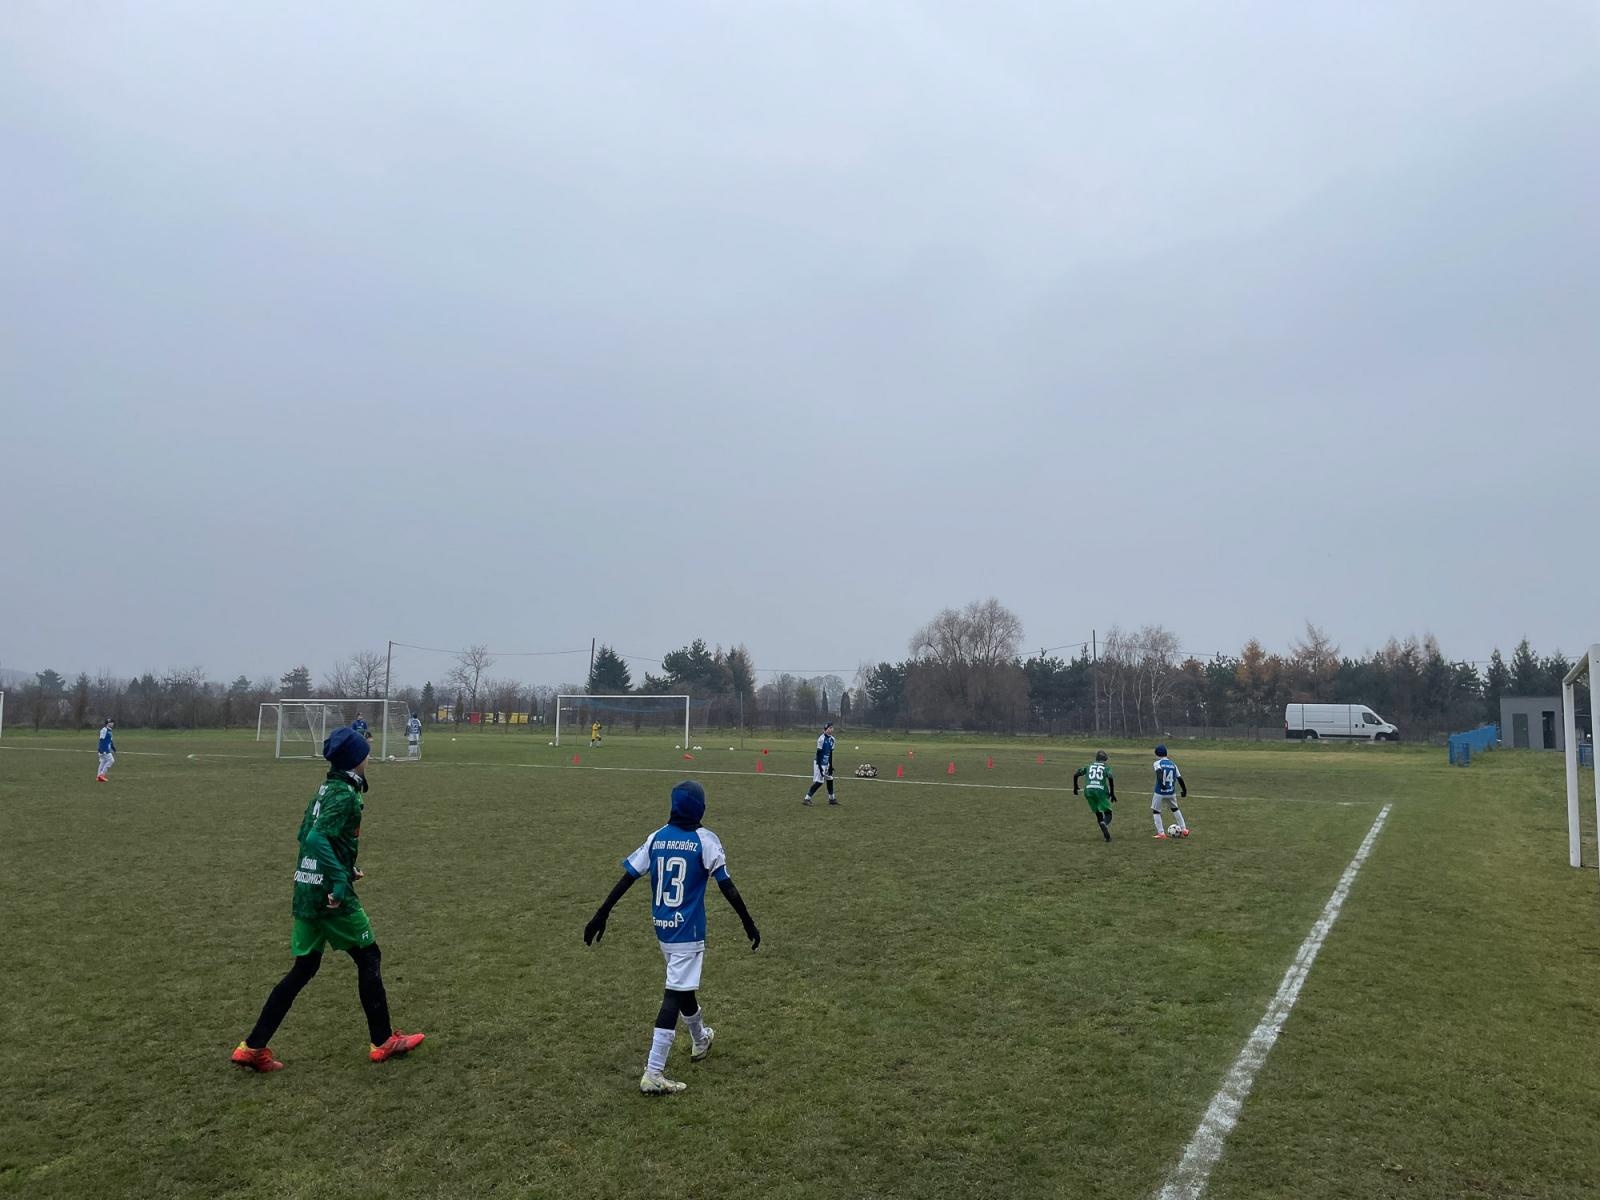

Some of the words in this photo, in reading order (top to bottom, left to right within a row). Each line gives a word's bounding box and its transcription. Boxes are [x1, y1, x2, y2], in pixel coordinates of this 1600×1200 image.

[1088, 765, 1105, 780] 55
[1162, 769, 1174, 786] 14
[655, 856, 687, 908] 13
